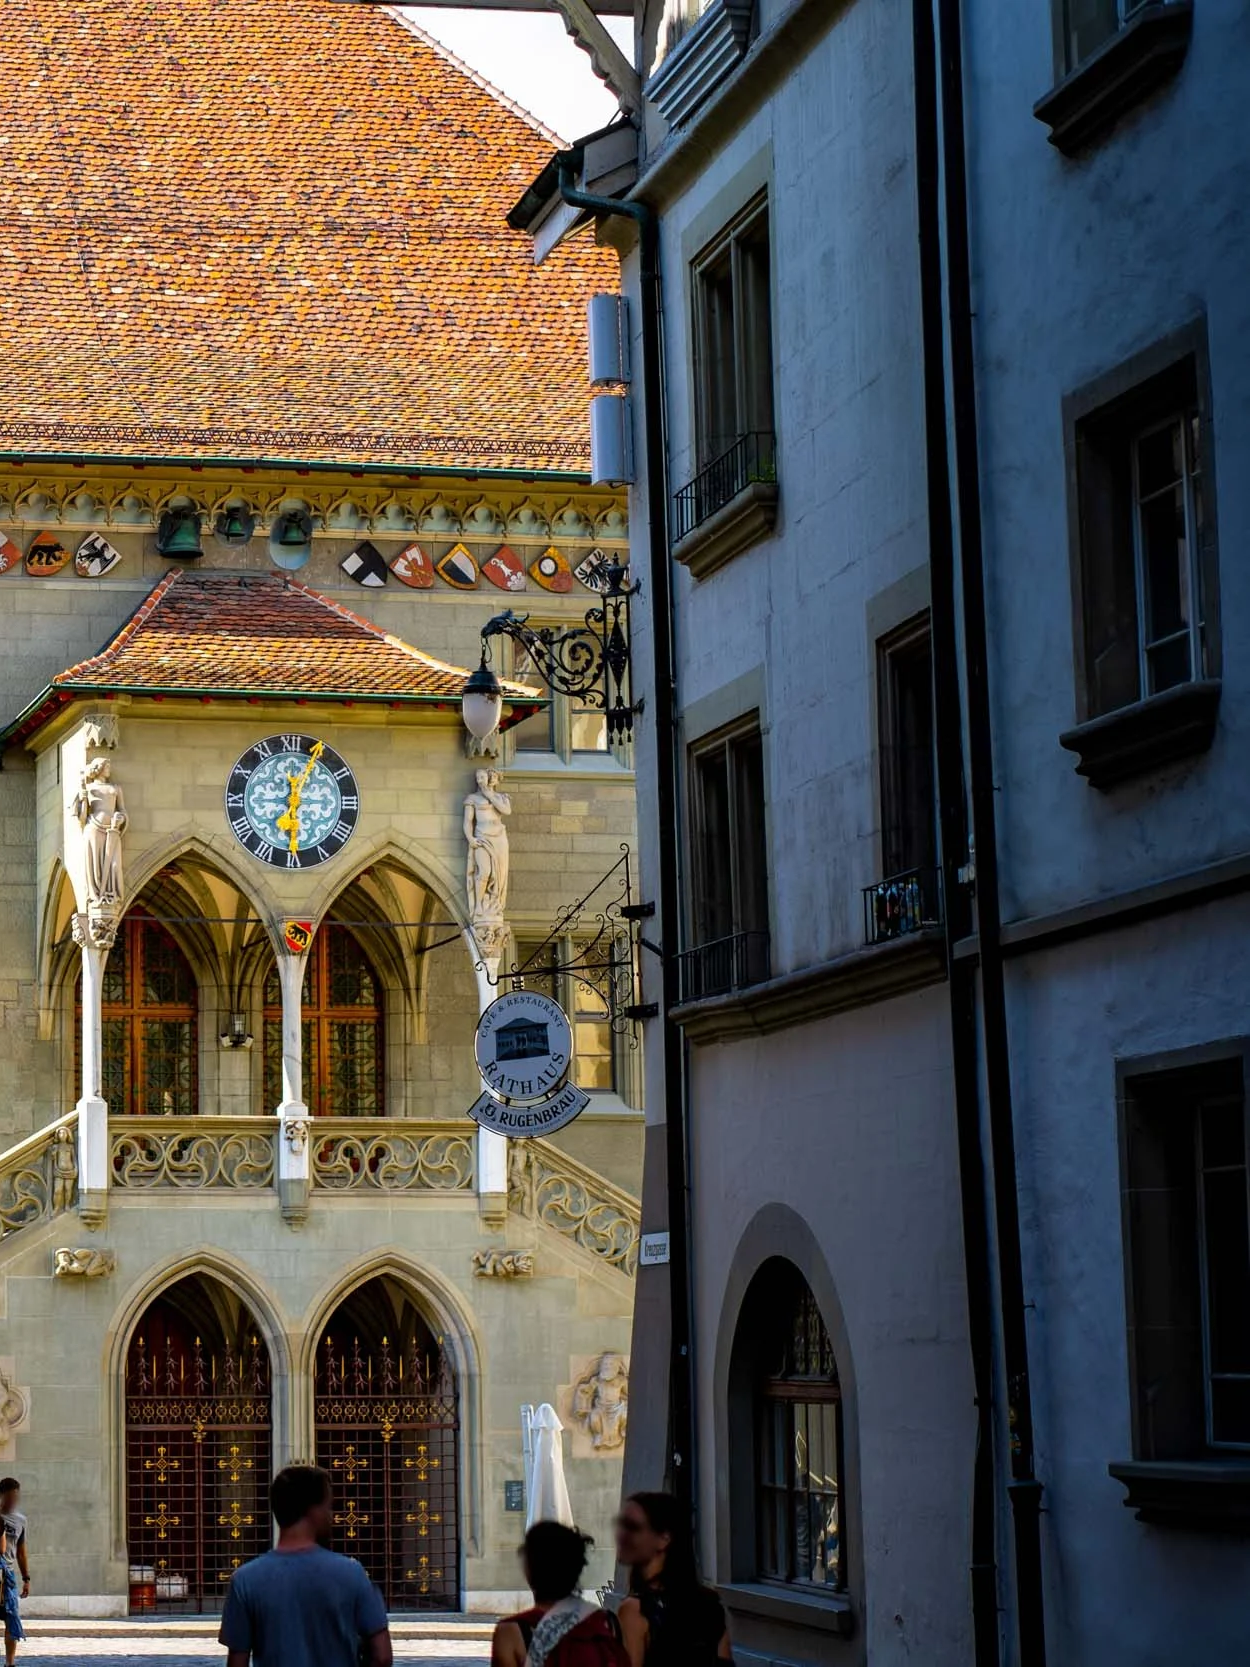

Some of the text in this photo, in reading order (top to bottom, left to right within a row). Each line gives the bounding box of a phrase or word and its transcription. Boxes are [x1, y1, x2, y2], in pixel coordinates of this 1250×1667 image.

[254, 742, 272, 760] XI
[280, 735, 301, 752] XII
[234, 764, 252, 779] X
[333, 766, 350, 780] II
[227, 792, 244, 807] IX
[341, 795, 358, 810] III
[253, 840, 274, 862] VII
[317, 845, 329, 861] V
[507, 997, 563, 1028] RESTAURANT
[484, 1051, 565, 1095] RATHAUS
[499, 1089, 575, 1127] RUGENBRÄU
